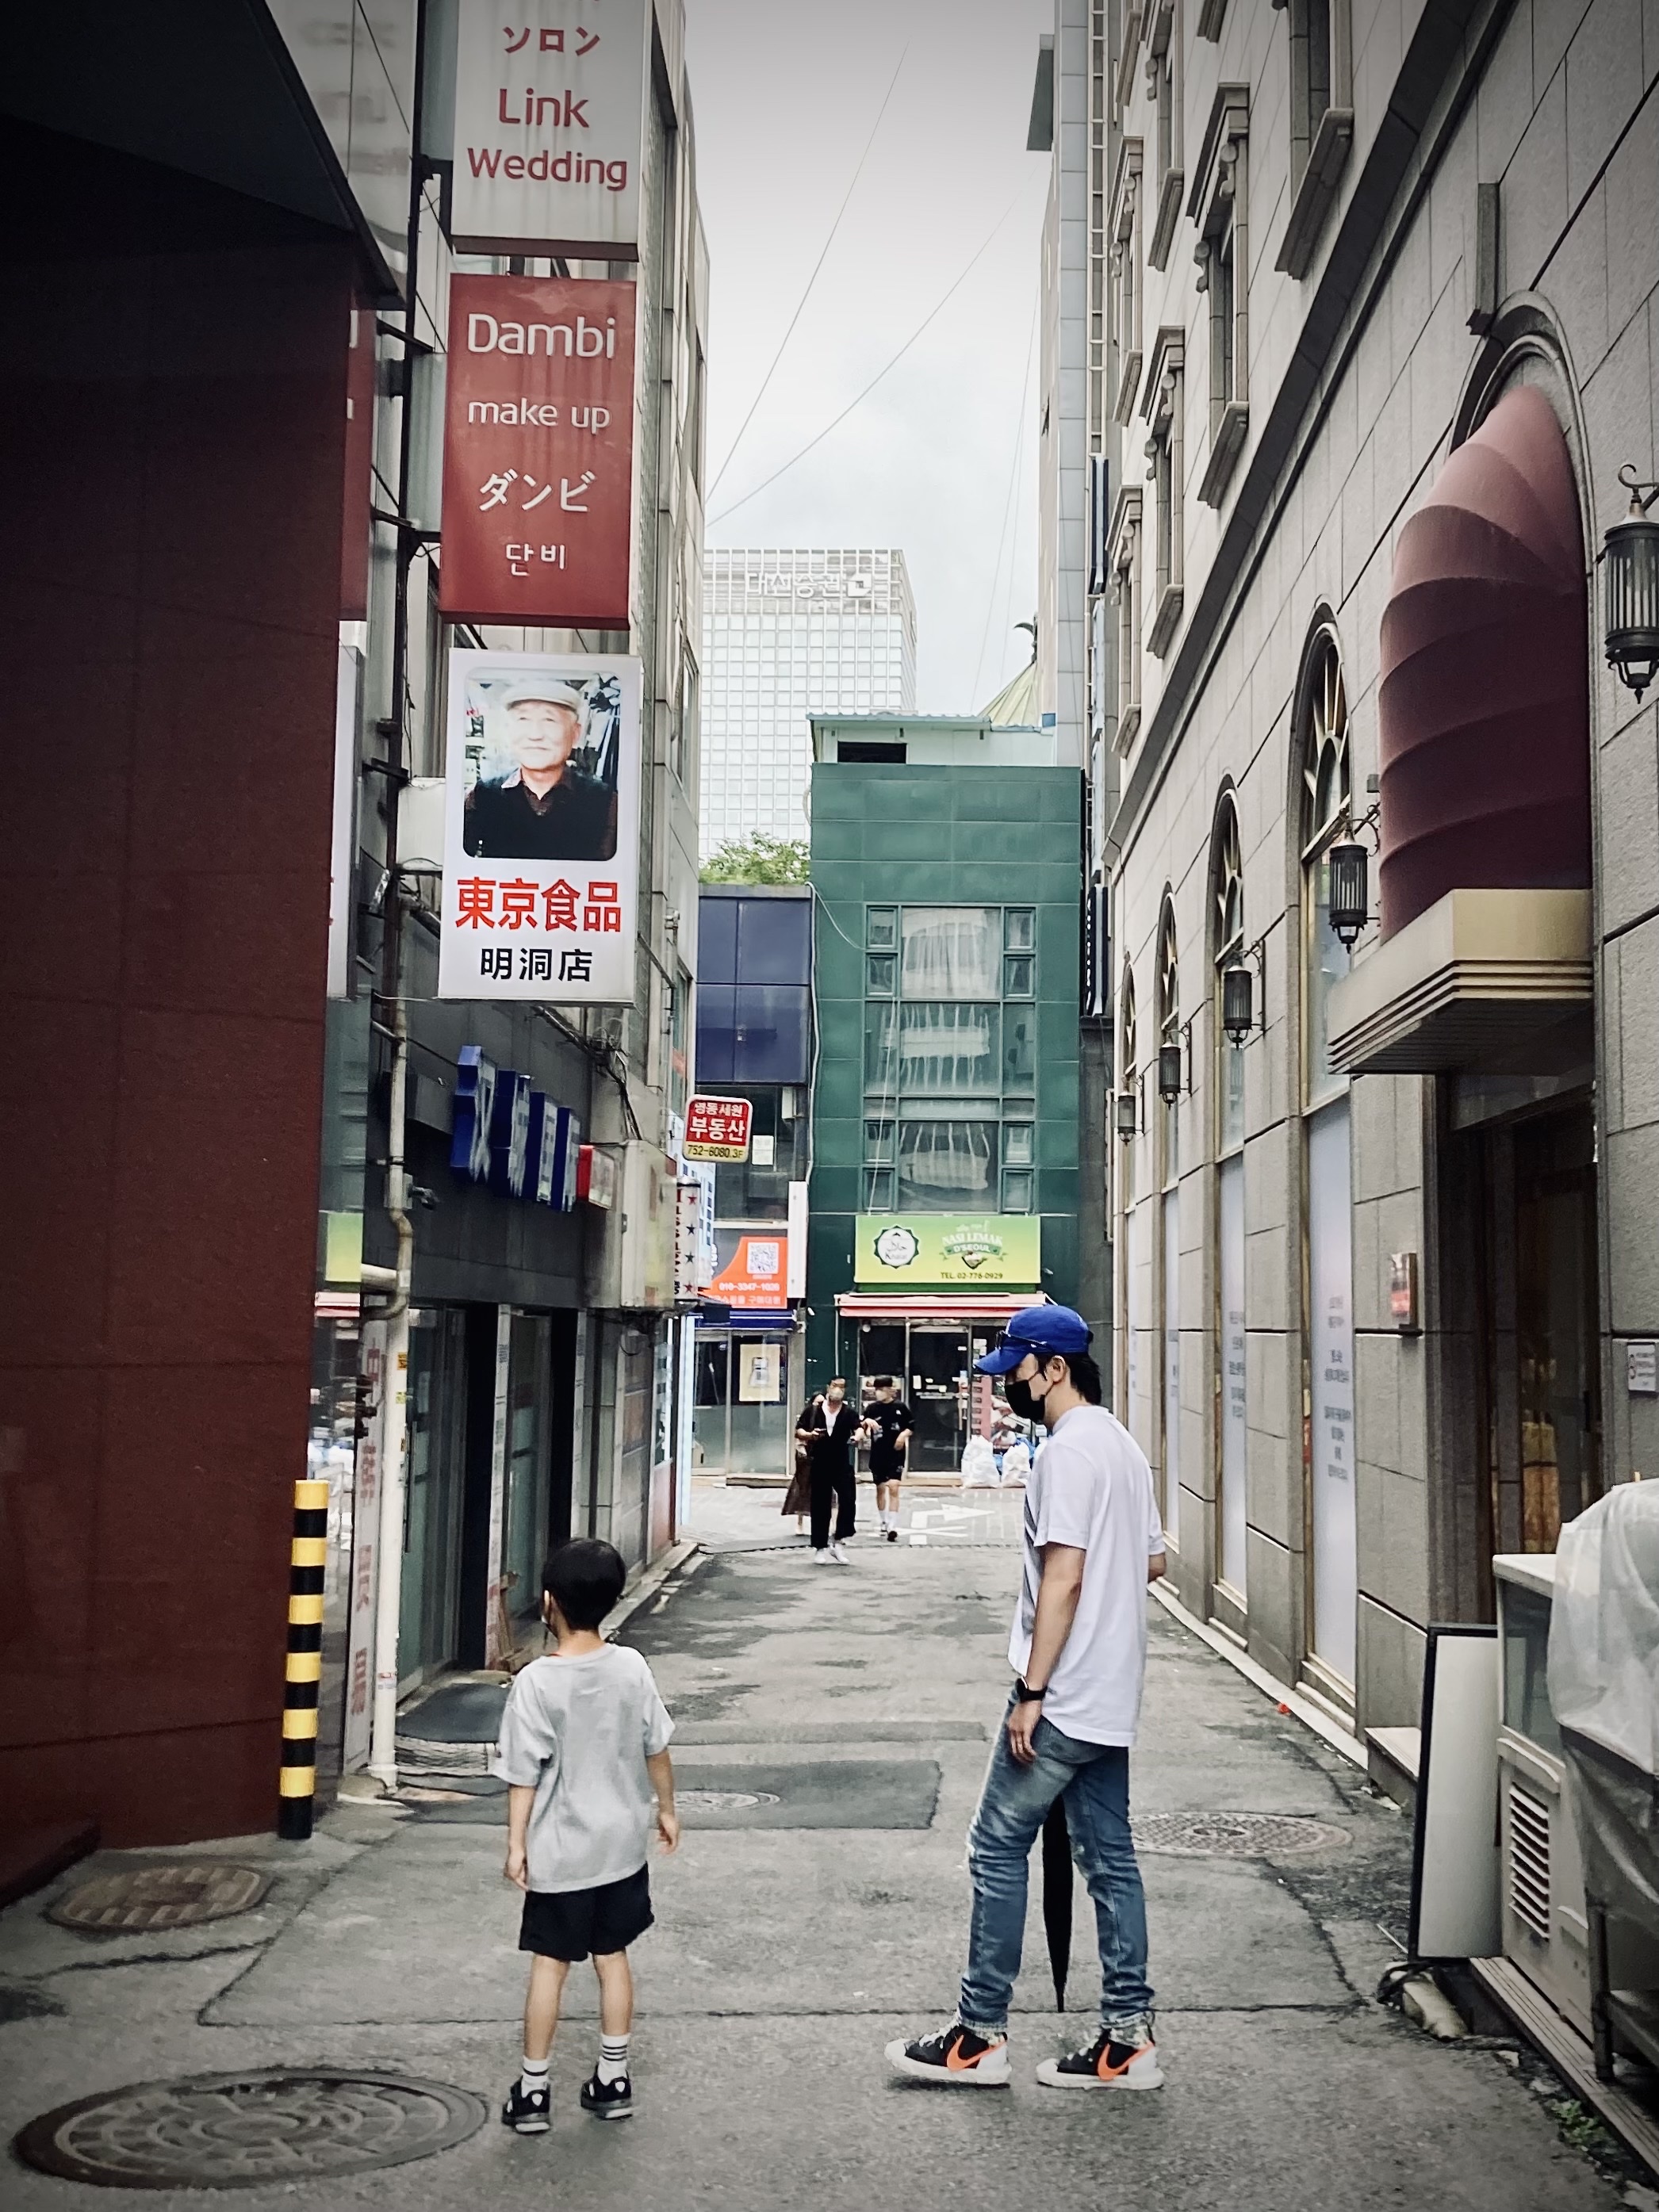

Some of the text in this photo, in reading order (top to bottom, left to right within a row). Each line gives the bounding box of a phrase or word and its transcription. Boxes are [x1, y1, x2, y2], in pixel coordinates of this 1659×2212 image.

[498, 87, 589, 128] Link
[466, 147, 628, 192] Wedding
[467, 312, 616, 360] Dambi
[468, 397, 611, 435] make up
[478, 468, 596, 513] ダンビ
[505, 542, 566, 577] 단비
[454, 875, 622, 932] 東京食品
[479, 946, 593, 983] 明洞店
[689, 1116, 745, 1142] 부동산
